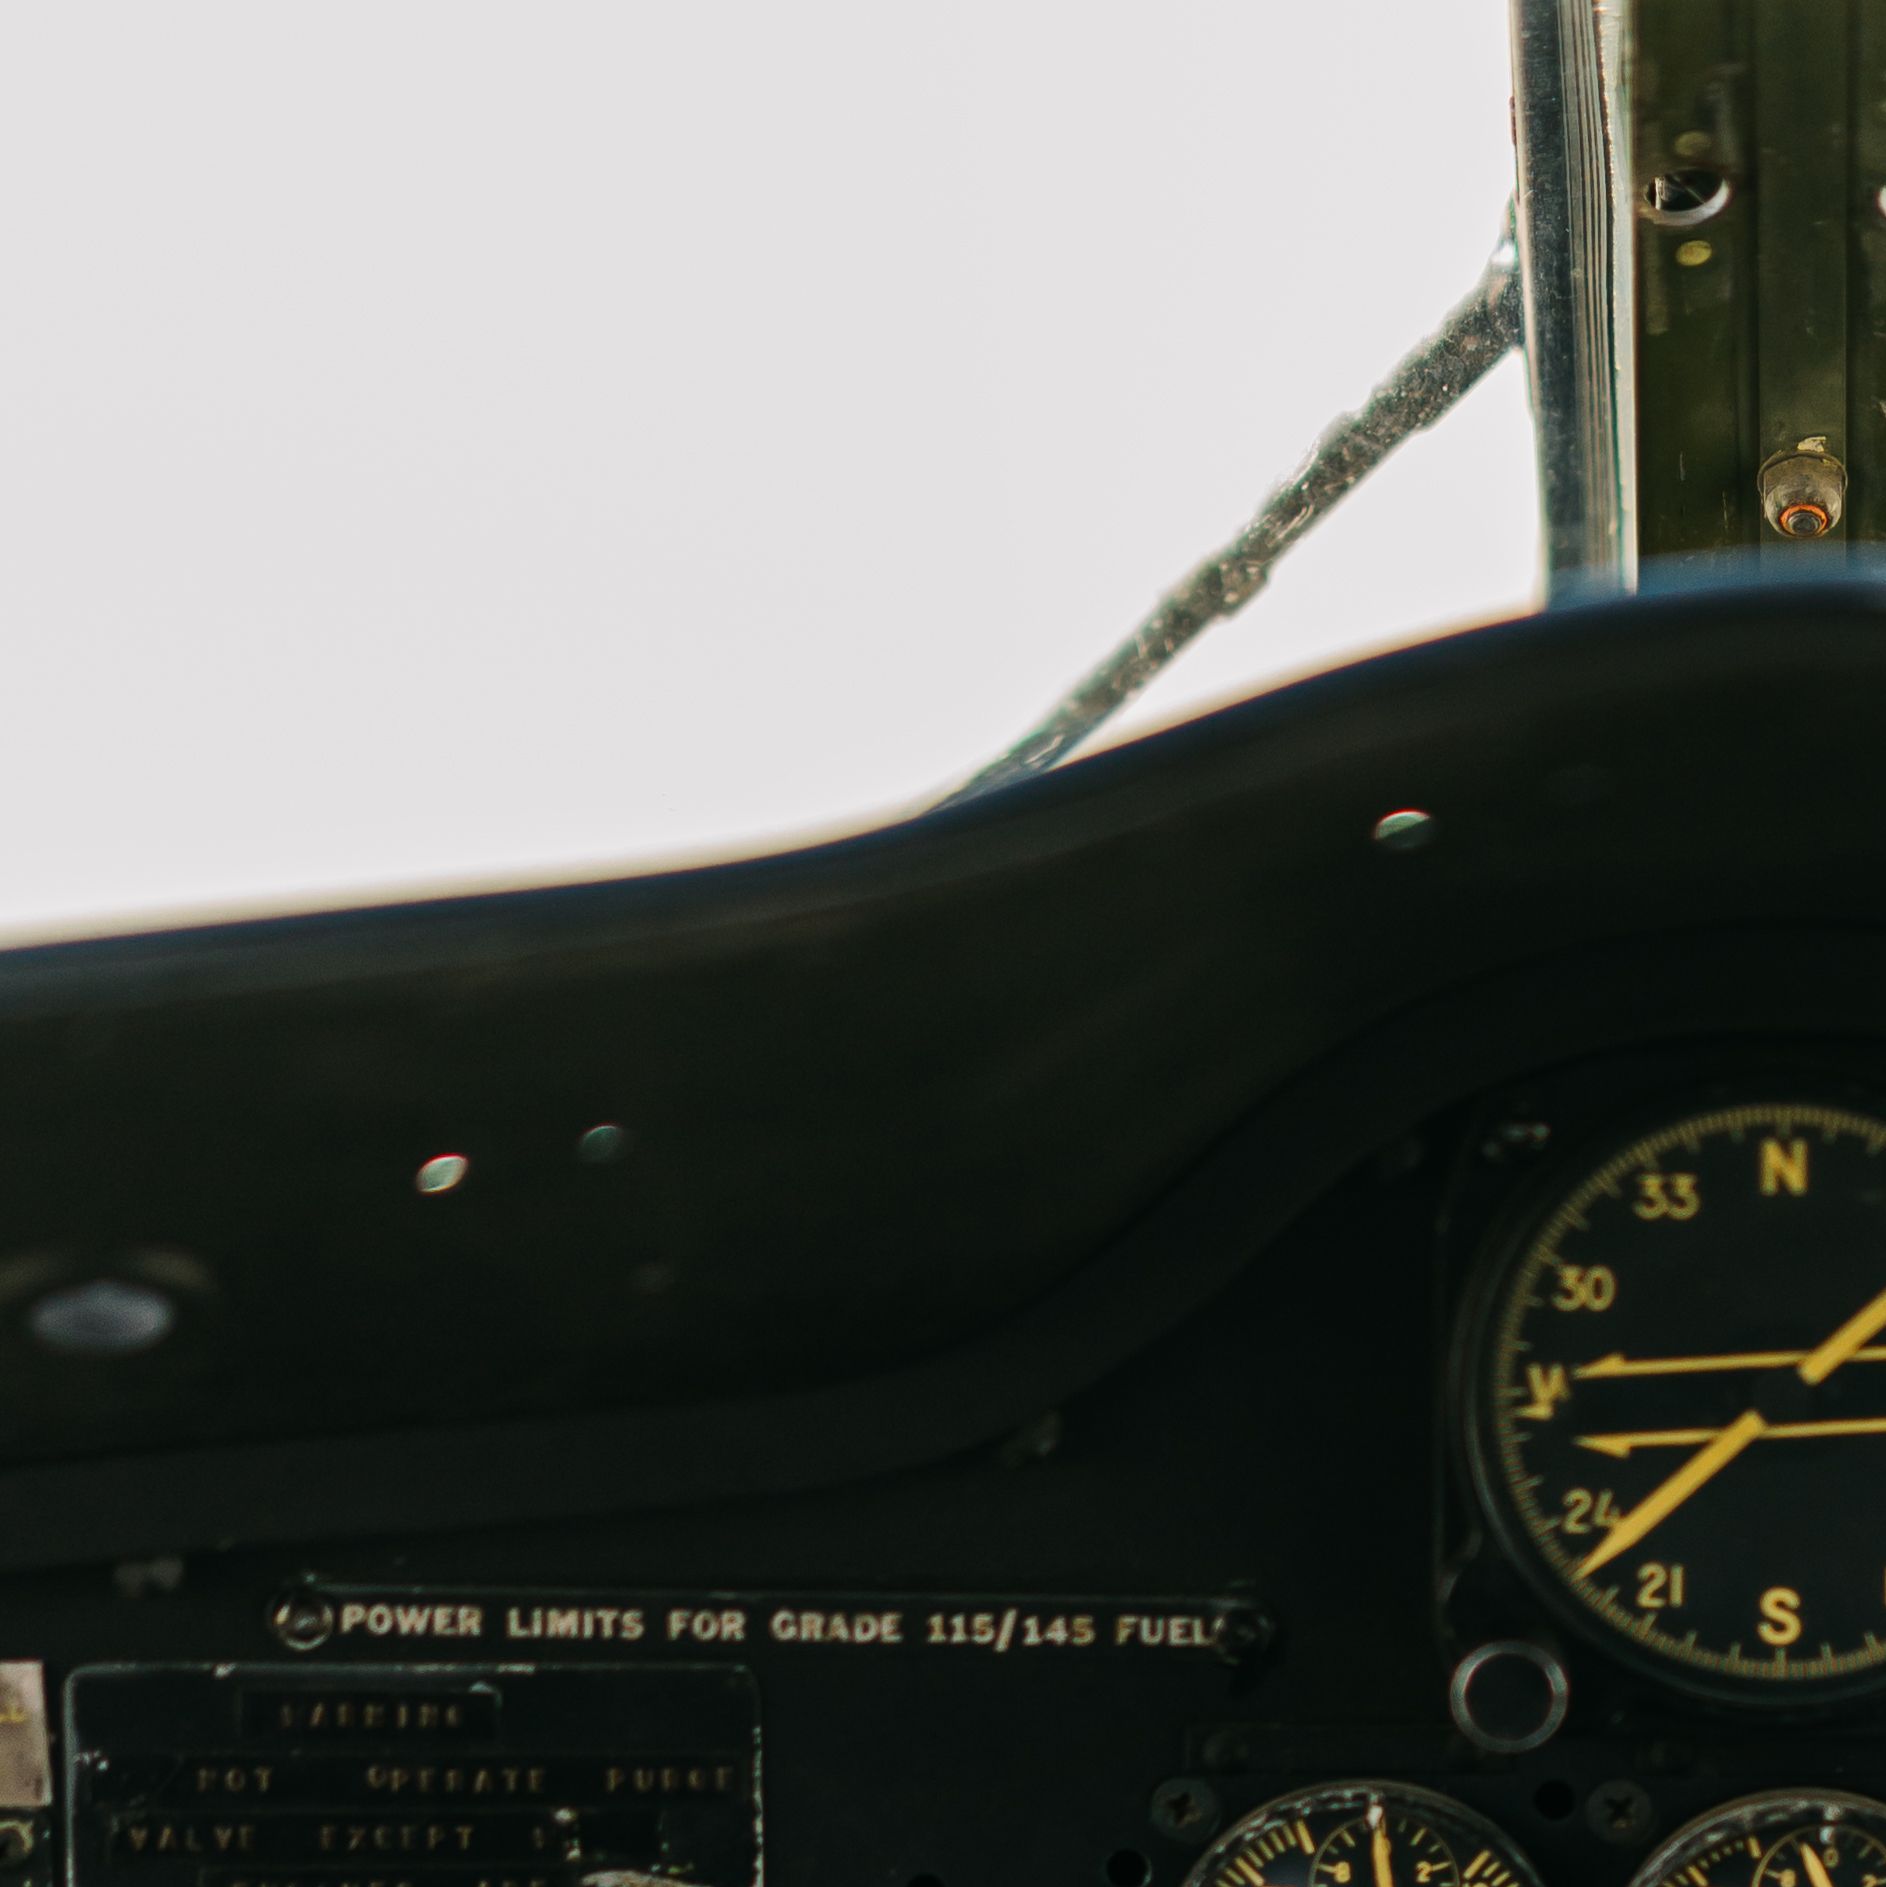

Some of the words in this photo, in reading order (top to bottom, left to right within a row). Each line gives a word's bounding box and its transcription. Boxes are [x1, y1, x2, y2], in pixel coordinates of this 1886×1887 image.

[1761, 1140, 1808, 1196] N
[1634, 1174, 1699, 1221] 33
[1554, 1265, 1616, 1312] 30
[341, 1605, 482, 1636] POWER
[506, 1608, 645, 1639] LIMITS
[668, 1611, 746, 1641] FOR
[771, 1609, 902, 1644] GRADE
[926, 1609, 1095, 1653] 115/145
[1115, 1616, 1222, 1647] FUEL
[1759, 1586, 1801, 1646] S
